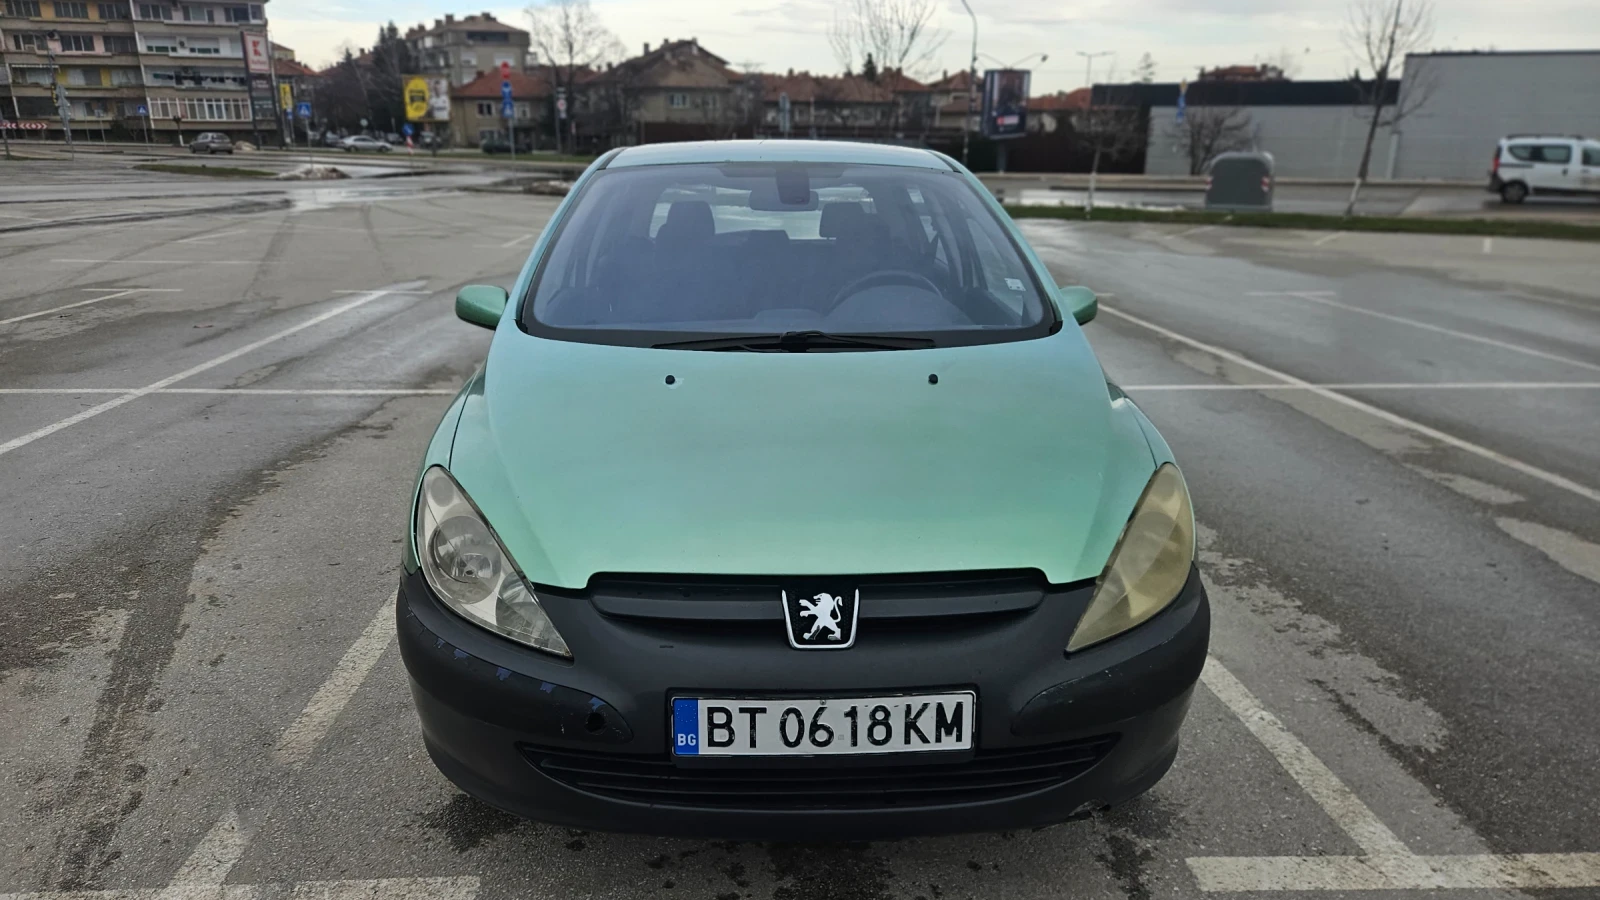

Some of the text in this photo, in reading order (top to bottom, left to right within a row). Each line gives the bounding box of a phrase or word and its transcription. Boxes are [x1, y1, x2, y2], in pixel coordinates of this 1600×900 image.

[677, 733, 696, 746] BG
[706, 701, 964, 749] BT 0618 KM
